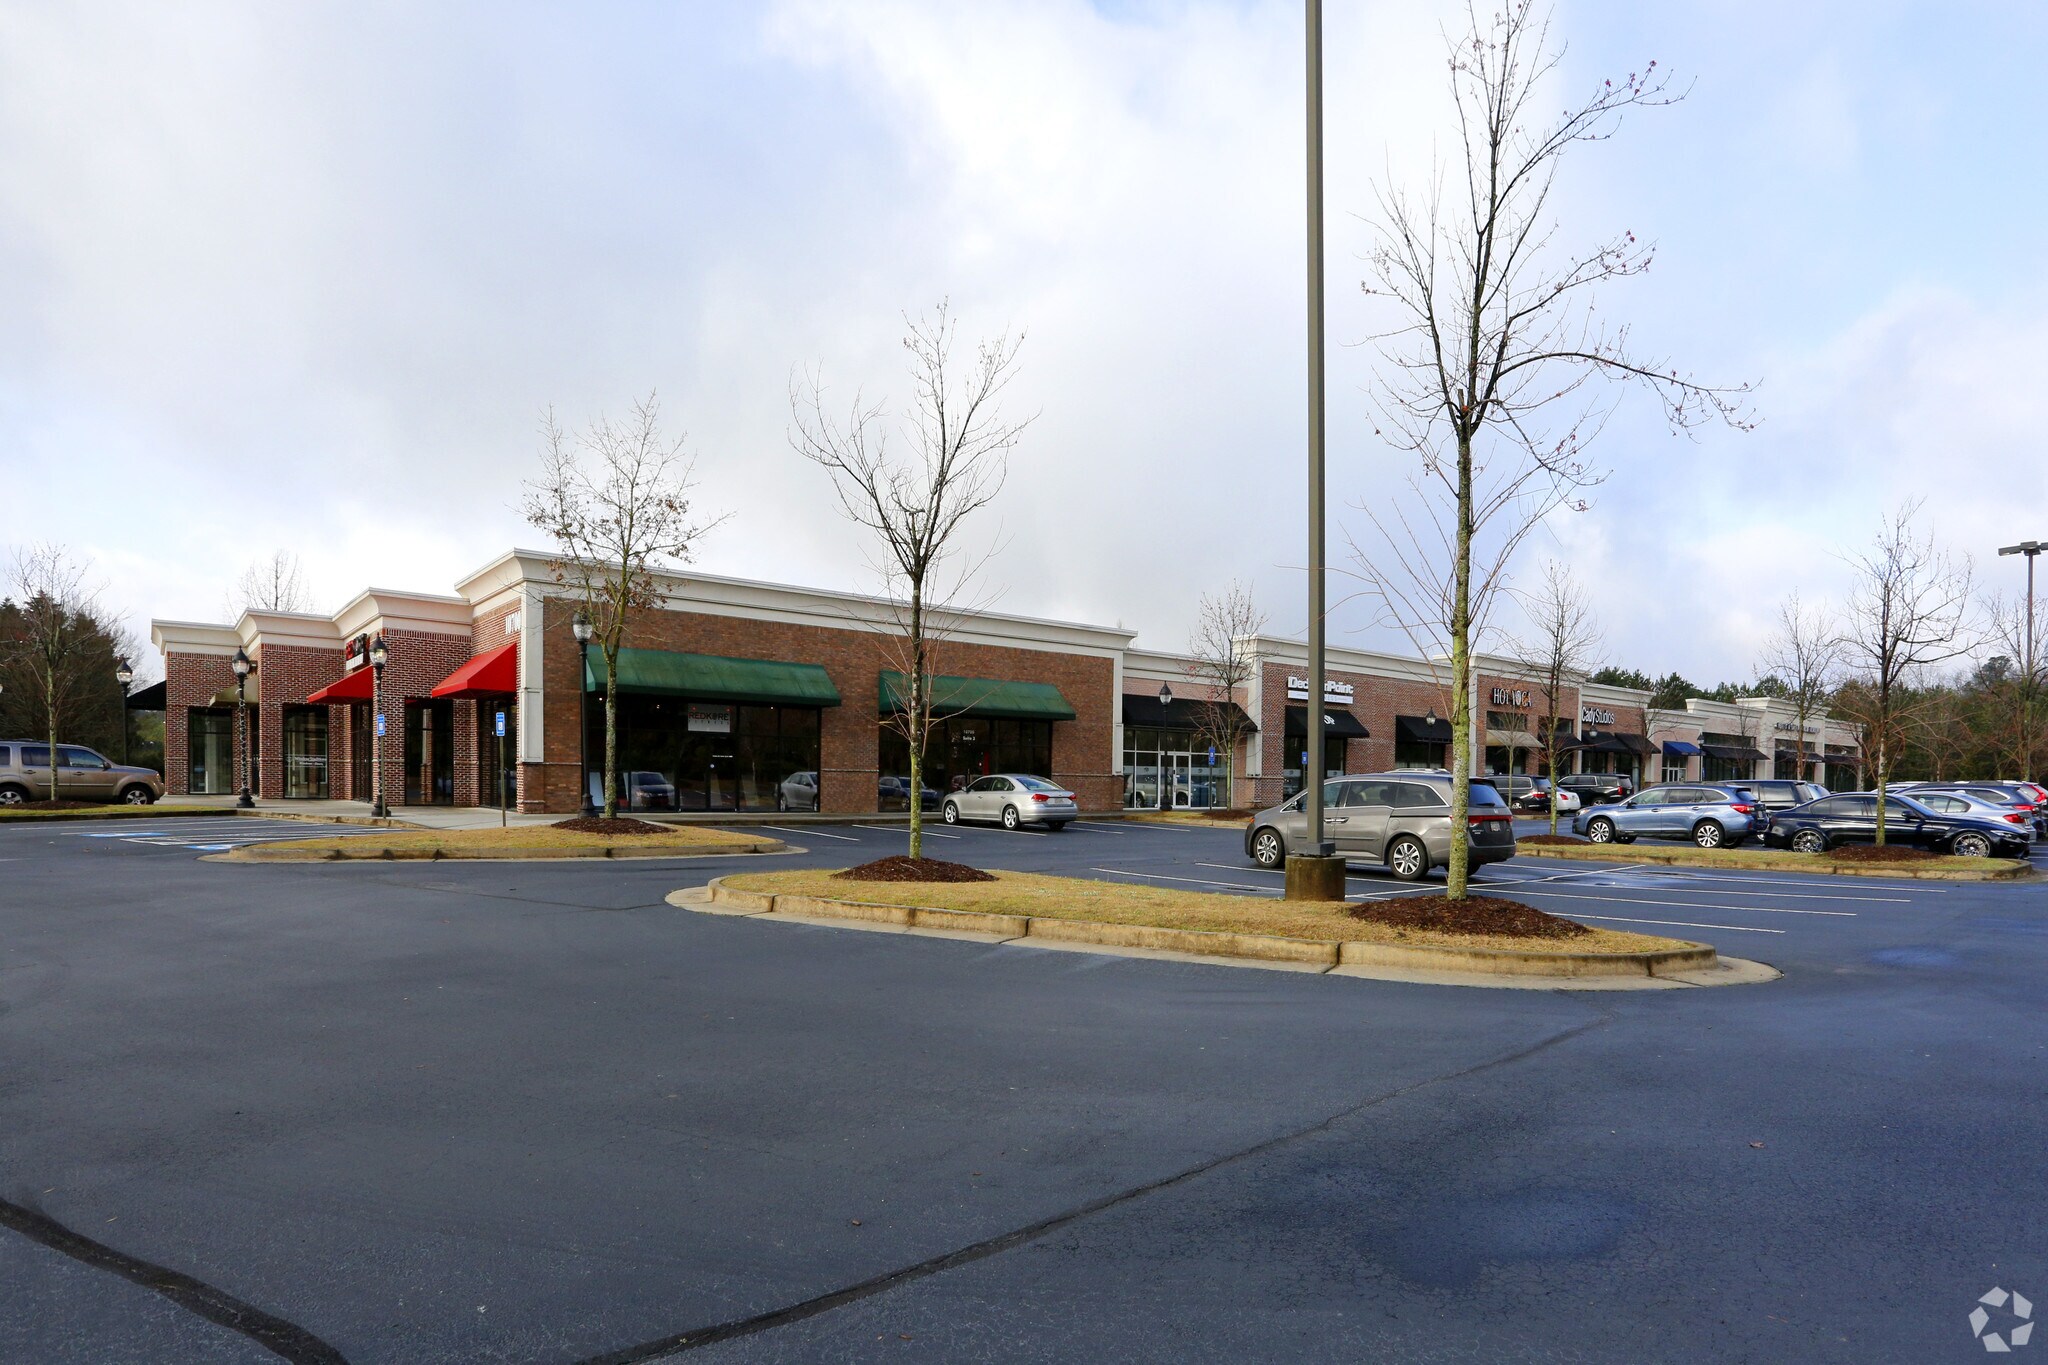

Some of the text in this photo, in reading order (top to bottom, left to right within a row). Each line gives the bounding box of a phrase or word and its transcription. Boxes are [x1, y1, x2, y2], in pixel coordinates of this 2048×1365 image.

[1492, 688, 1509, 705] HOT
[1581, 706, 1615, 726] Cady Studios
